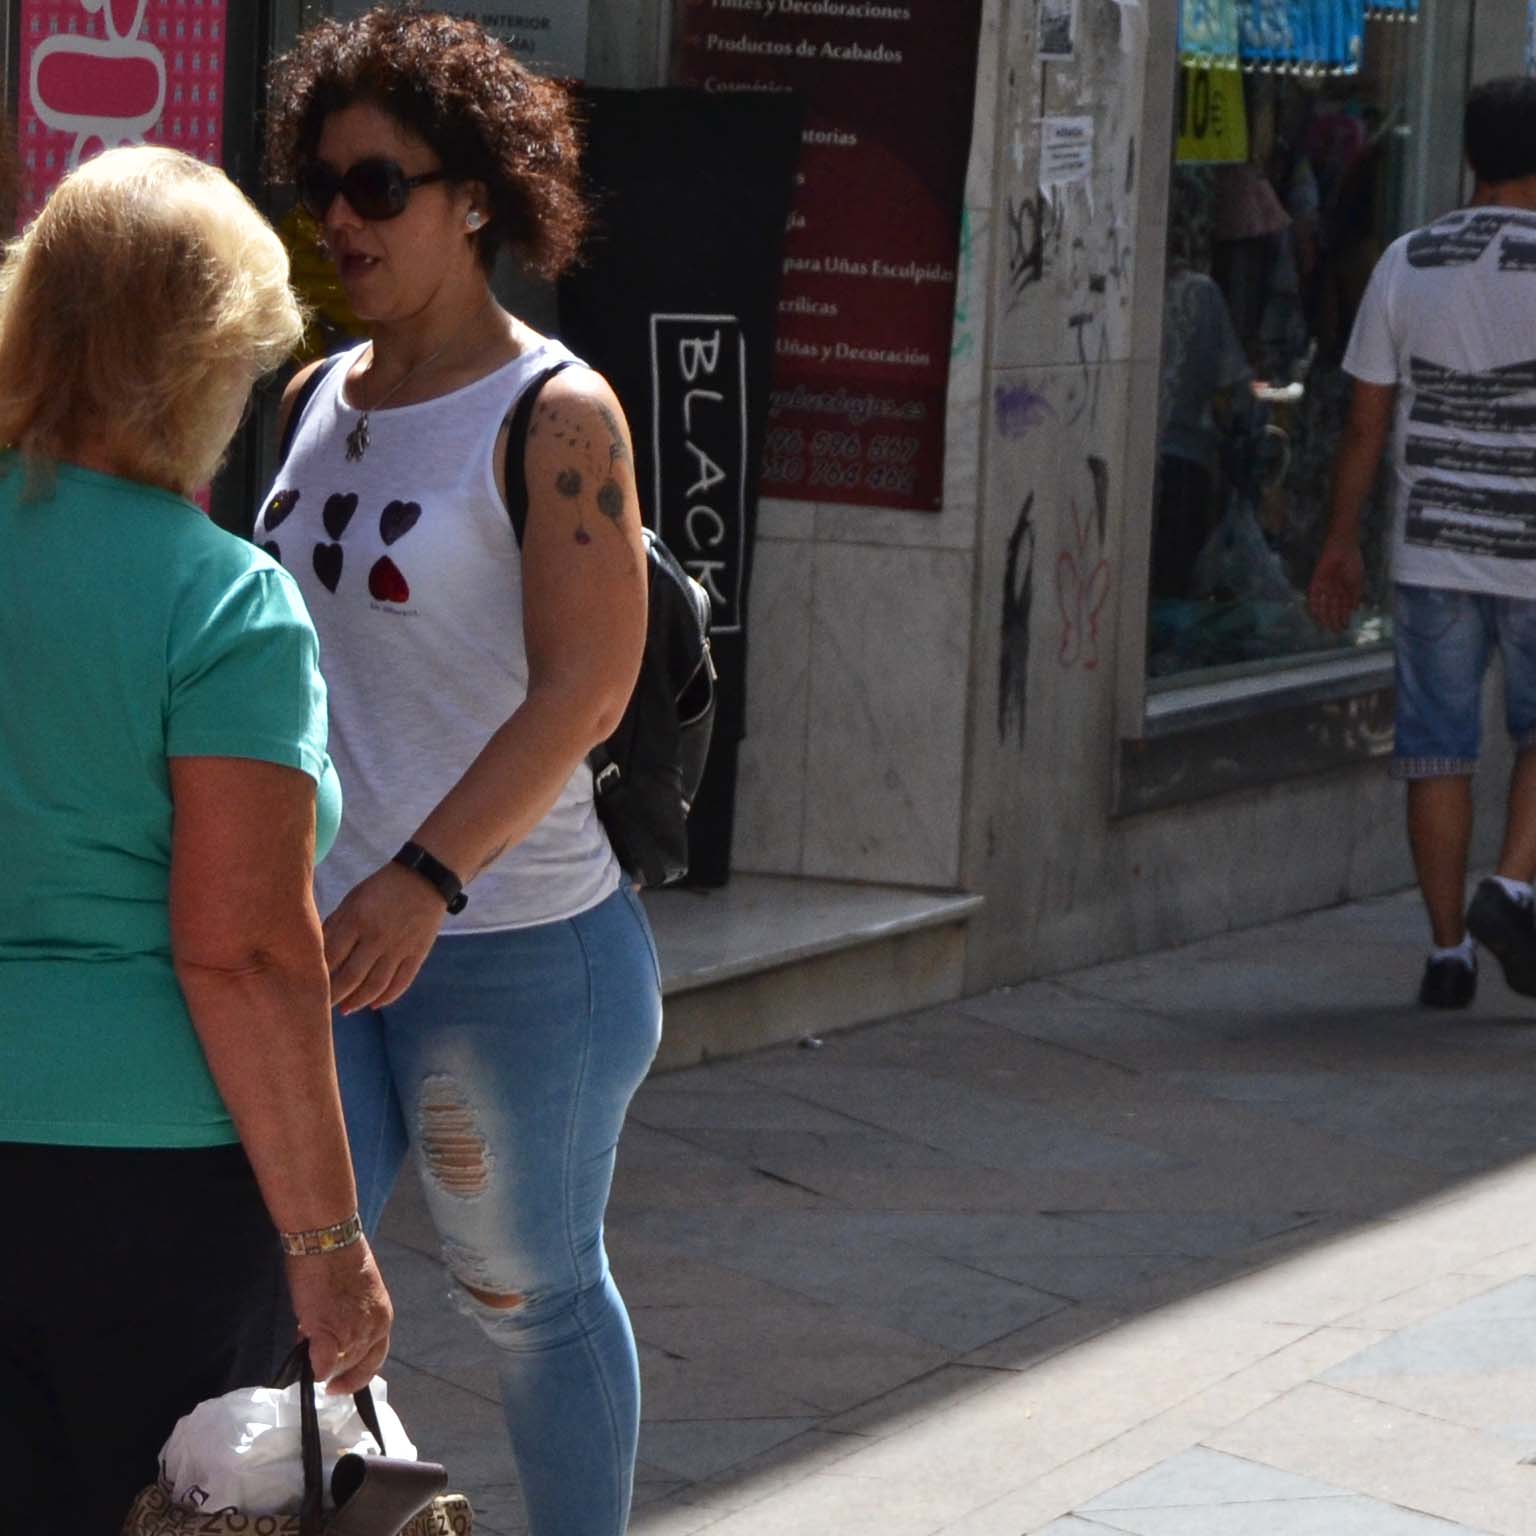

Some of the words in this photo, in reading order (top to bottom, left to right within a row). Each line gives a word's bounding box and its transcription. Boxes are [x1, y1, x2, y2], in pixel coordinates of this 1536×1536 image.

[778, 0, 911, 20] Decoloraciones
[706, 33, 793, 58] Productos
[795, 38, 816, 57] de
[819, 42, 903, 64] Acabados
[782, 256, 821, 275] para
[824, 255, 867, 276] Uñas
[820, 343, 833, 363] y
[834, 341, 930, 367] Decoración
[679, 329, 728, 605] BLACK
